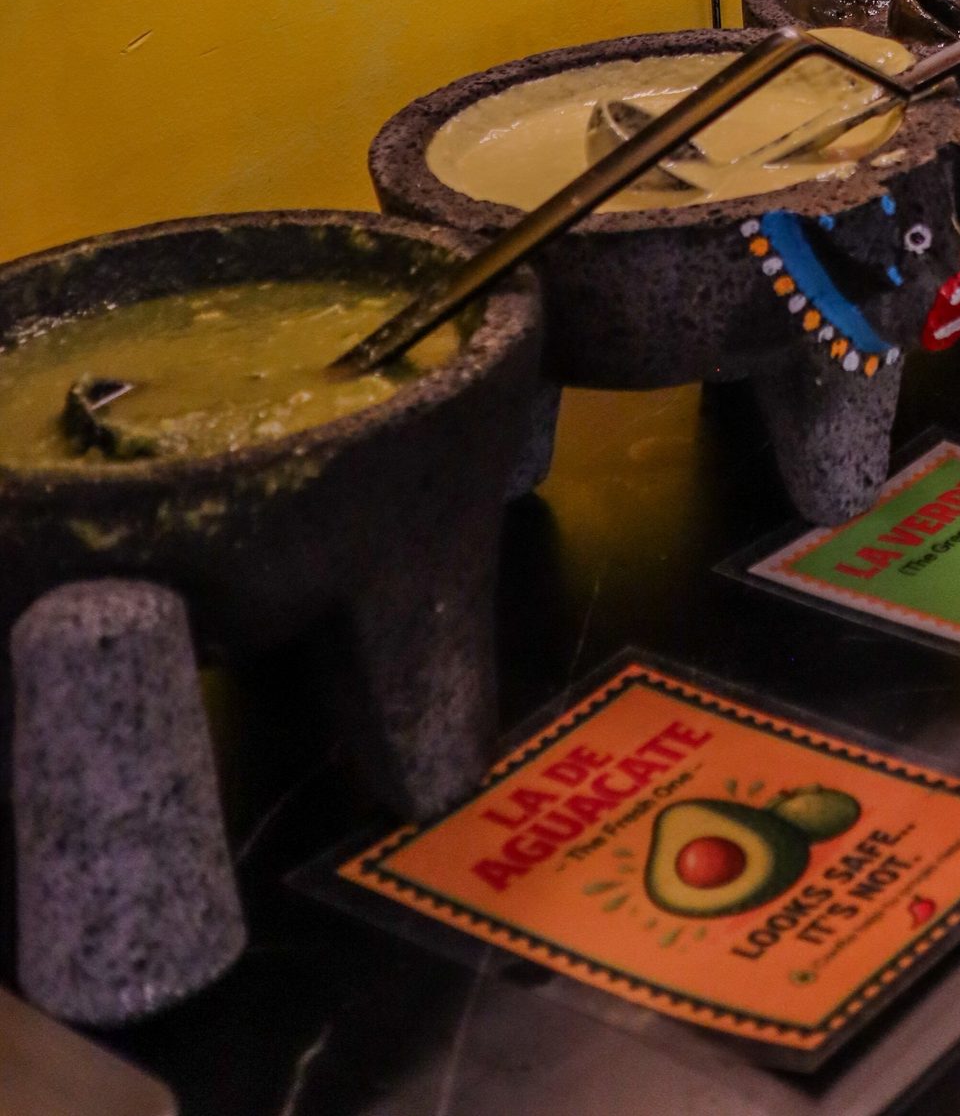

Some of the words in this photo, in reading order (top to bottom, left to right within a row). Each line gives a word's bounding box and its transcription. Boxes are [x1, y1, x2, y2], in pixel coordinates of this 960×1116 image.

[830, 546, 902, 580] LA
[896, 552, 937, 576] (The
[472, 722, 710, 891] AGUACATE
[478, 787, 558, 830] LA
[541, 745, 612, 786] DE
[564, 835, 606, 860] The
[601, 798, 656, 836] Fresh
[651, 771, 693, 798] One
[731, 885, 833, 960] LOOKS
[796, 902, 859, 945] IT'S
[847, 854, 919, 900] NOT.
